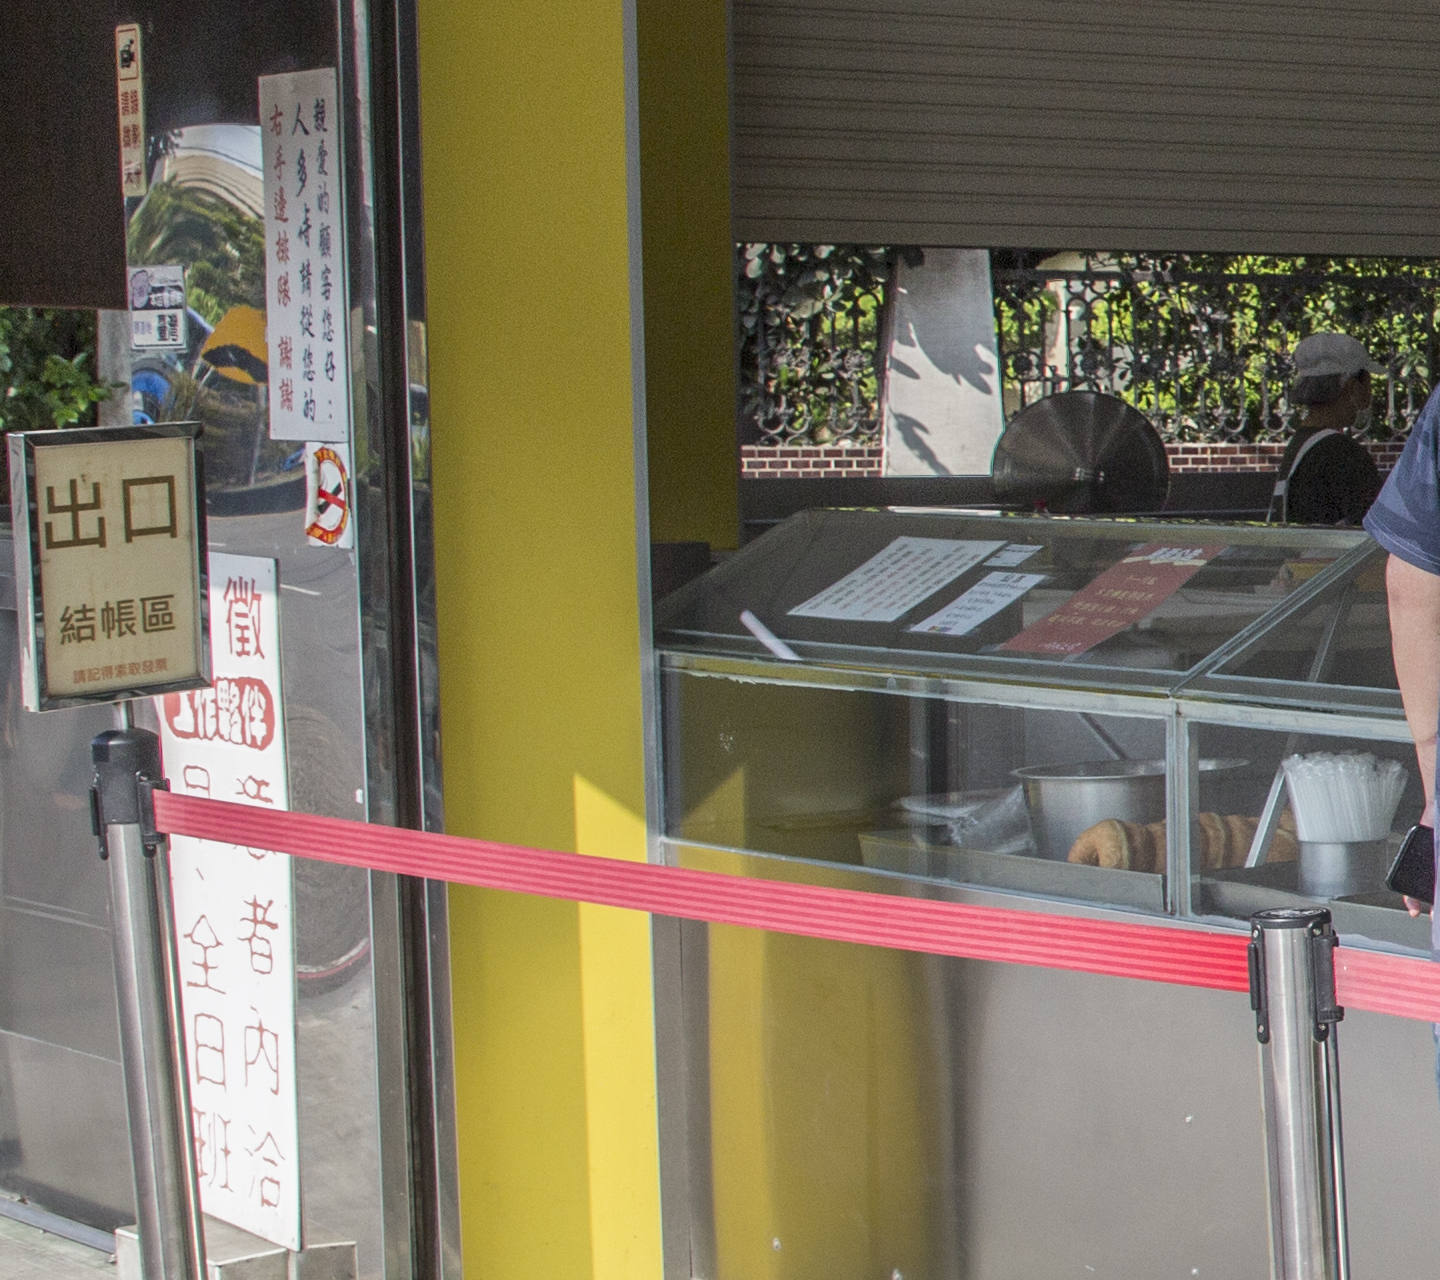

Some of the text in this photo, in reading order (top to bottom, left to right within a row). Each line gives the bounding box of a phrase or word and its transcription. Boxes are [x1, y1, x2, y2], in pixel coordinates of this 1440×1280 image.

[45, 475, 178, 549] 出口
[60, 594, 175, 645] 結帳區
[224, 576, 265, 659] 徵
